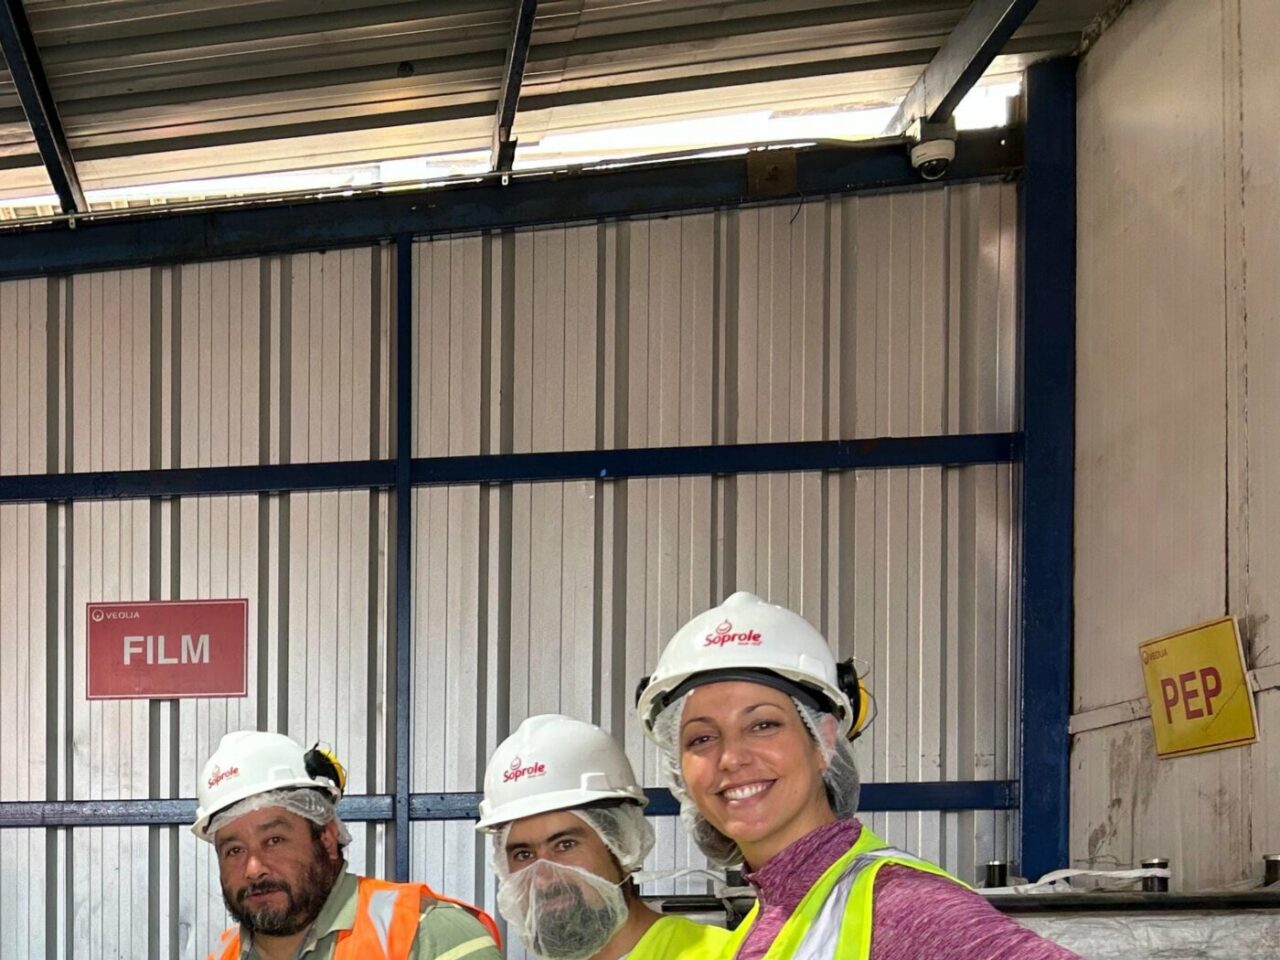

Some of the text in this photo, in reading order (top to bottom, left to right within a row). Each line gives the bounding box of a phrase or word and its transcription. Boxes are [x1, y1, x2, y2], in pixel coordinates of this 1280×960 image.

[106, 611, 140, 620] VEOLIA
[704, 630, 762, 647] Soprole
[123, 634, 210, 666] FILM
[1160, 666, 1223, 725] PEP
[207, 766, 239, 789] Soprole
[503, 762, 546, 783] Soprole
